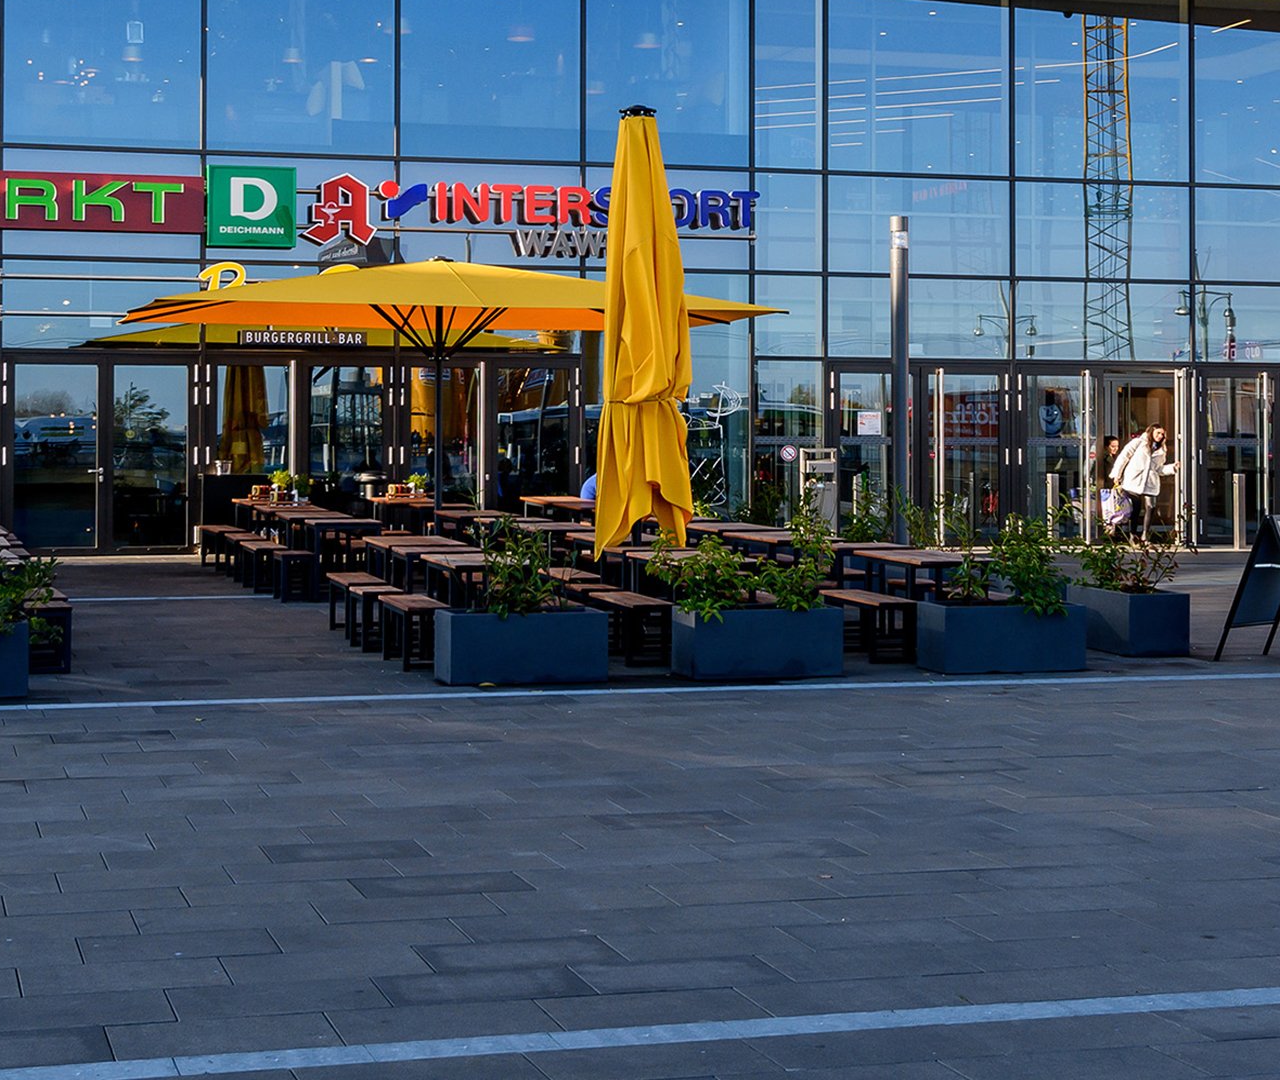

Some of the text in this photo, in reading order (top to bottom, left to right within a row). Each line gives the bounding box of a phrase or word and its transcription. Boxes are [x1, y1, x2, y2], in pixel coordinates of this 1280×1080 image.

[230, 176, 278, 221] D
[435, 182, 760, 229] INTERSORT
[219, 225, 285, 235] DEICHMANN
[245, 330, 362, 345] BURGERGRILL BAR
